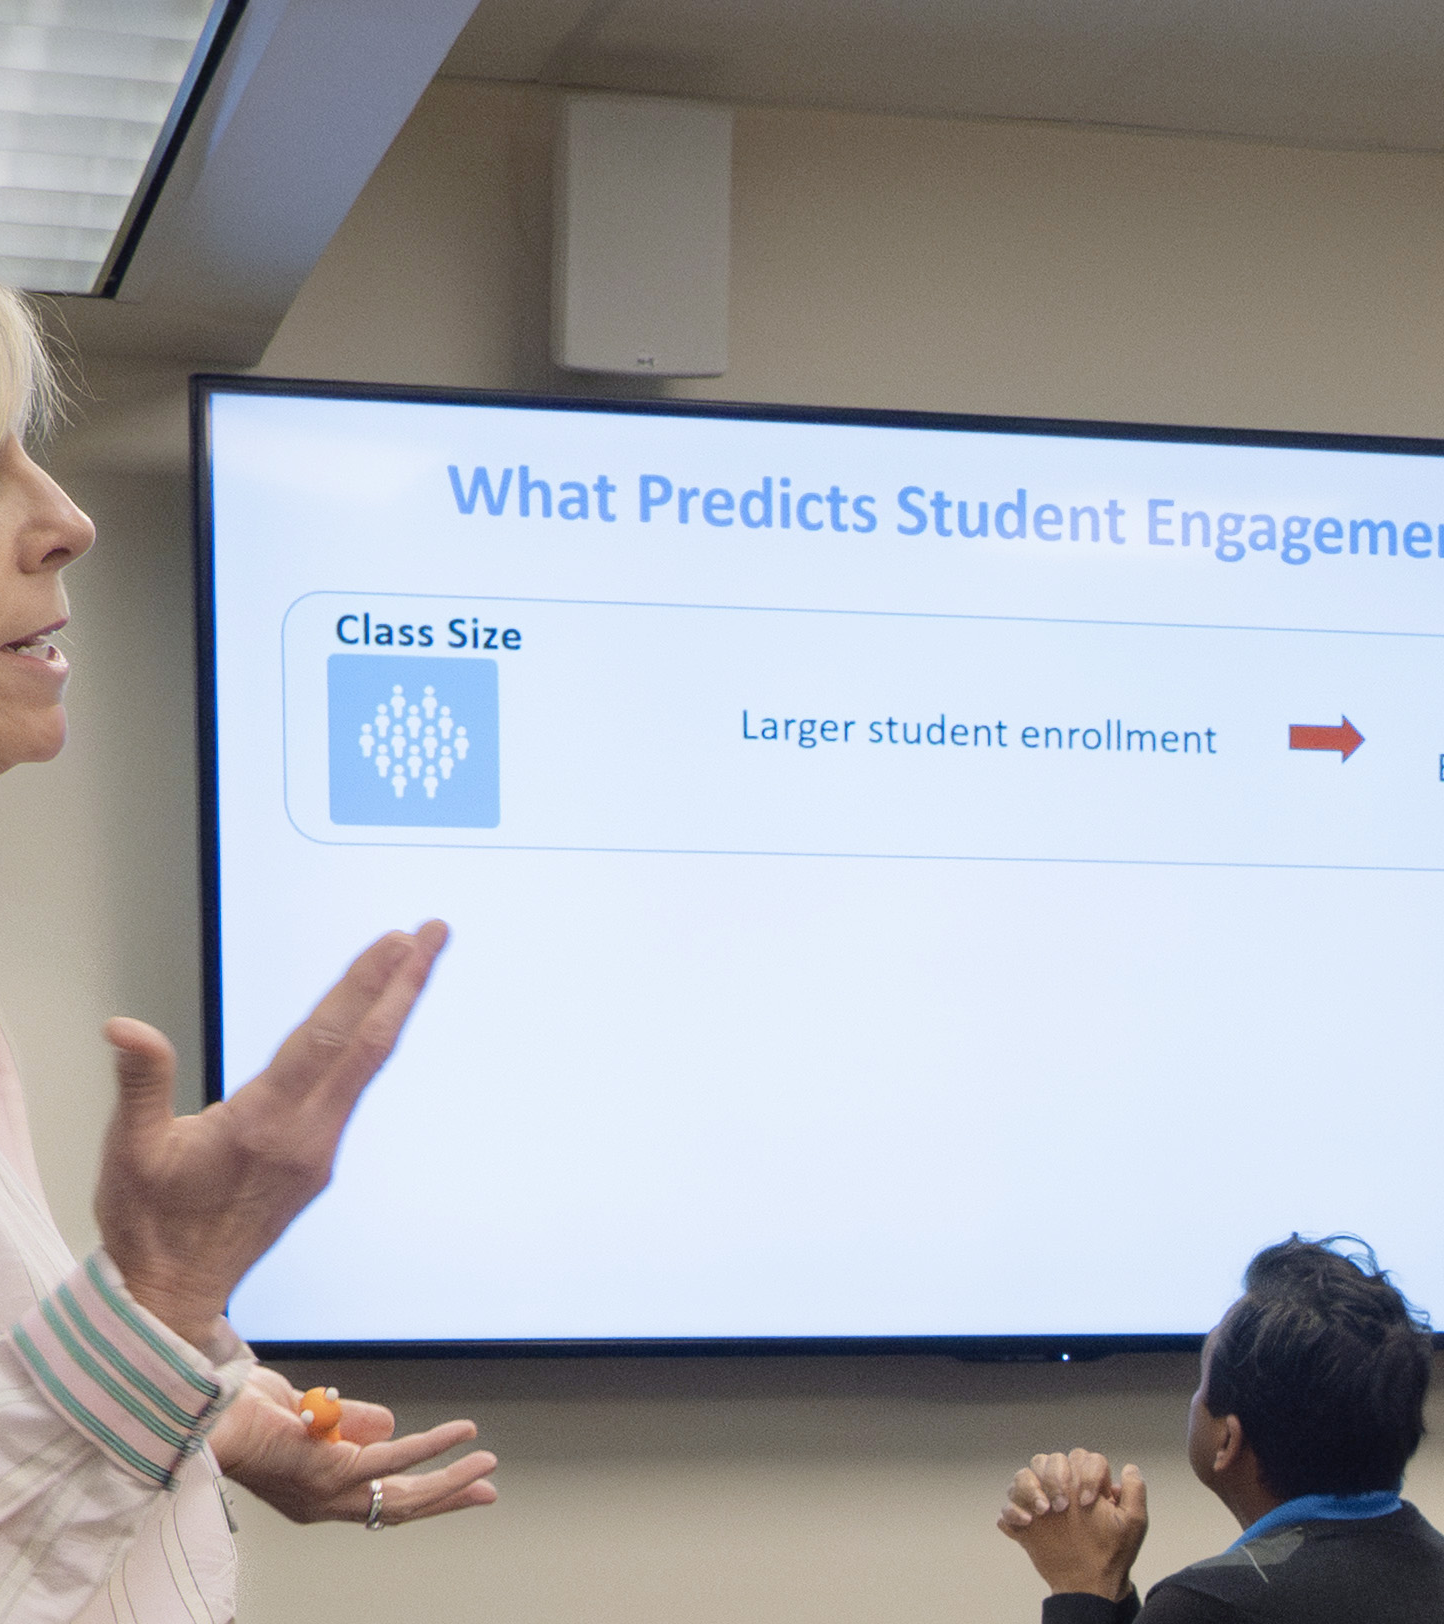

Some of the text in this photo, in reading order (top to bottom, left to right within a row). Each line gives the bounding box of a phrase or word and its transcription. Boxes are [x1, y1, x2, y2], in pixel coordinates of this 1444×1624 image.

[447, 464, 617, 523] What
[638, 473, 878, 534] Predicts
[895, 484, 1127, 546] Student
[335, 611, 523, 651] Class Size
[741, 708, 1218, 755] Larger student enrollment
